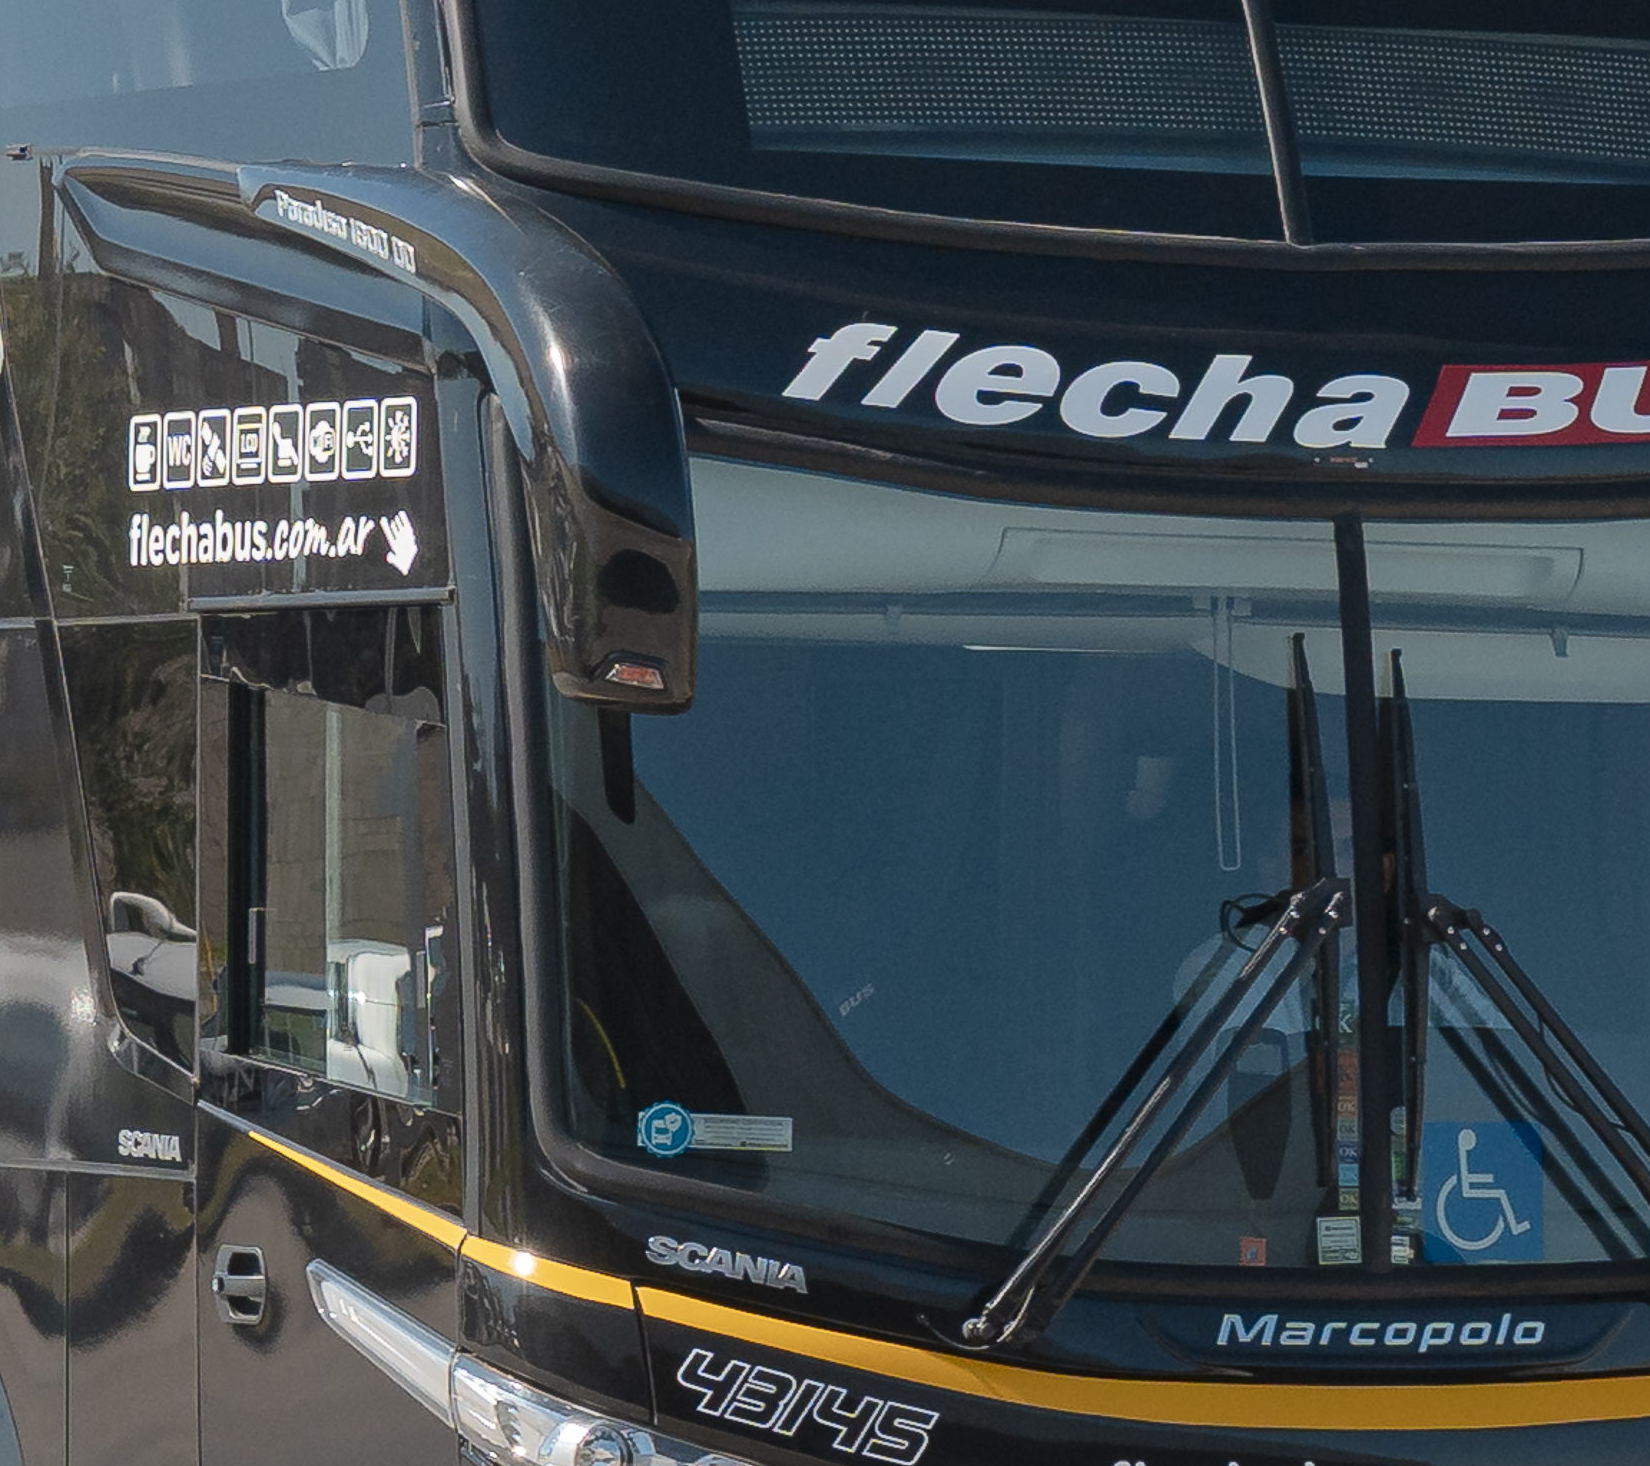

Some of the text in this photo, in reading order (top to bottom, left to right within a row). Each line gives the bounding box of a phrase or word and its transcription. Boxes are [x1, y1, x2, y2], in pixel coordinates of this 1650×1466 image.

[275, 189, 348, 240] Paradiso
[781, 322, 1409, 449] flecha
[167, 434, 191, 468] WC
[128, 509, 376, 567] flechabus.com.ar
[118, 1129, 182, 1163] SCANIA
[645, 1235, 808, 1295] SCANIA
[1216, 1312, 1547, 1353] Marcopolo
